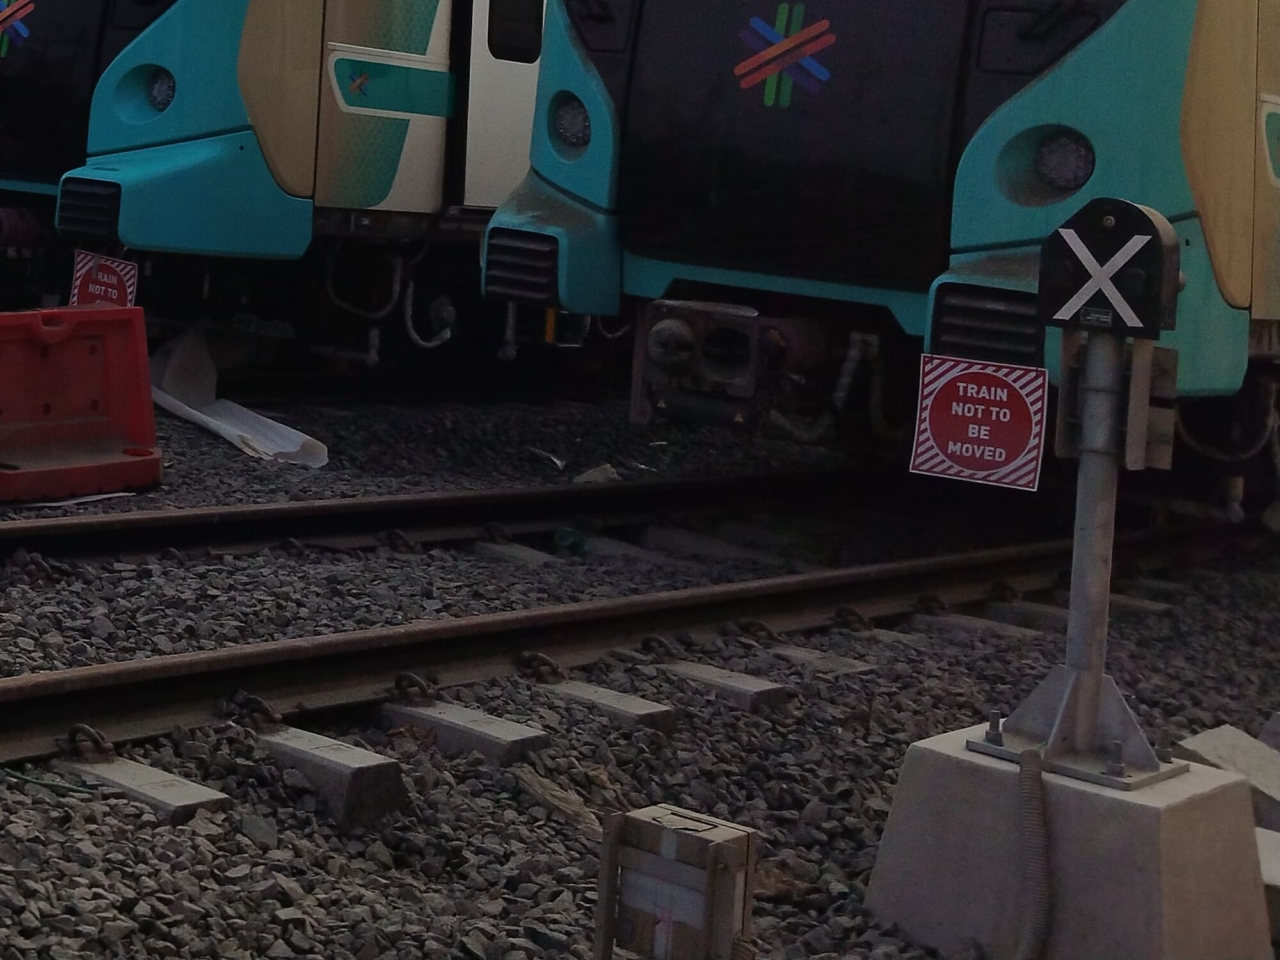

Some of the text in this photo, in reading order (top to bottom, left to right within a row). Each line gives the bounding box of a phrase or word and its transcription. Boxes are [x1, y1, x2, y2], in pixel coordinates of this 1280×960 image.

[93, 270, 118, 285] RAIN
[88, 283, 118, 299] NOT TO
[956, 382, 1008, 402] TRAIN
[951, 402, 1010, 422] NOT TO
[968, 424, 990, 440] BE
[947, 440, 1006, 462] MOVED
